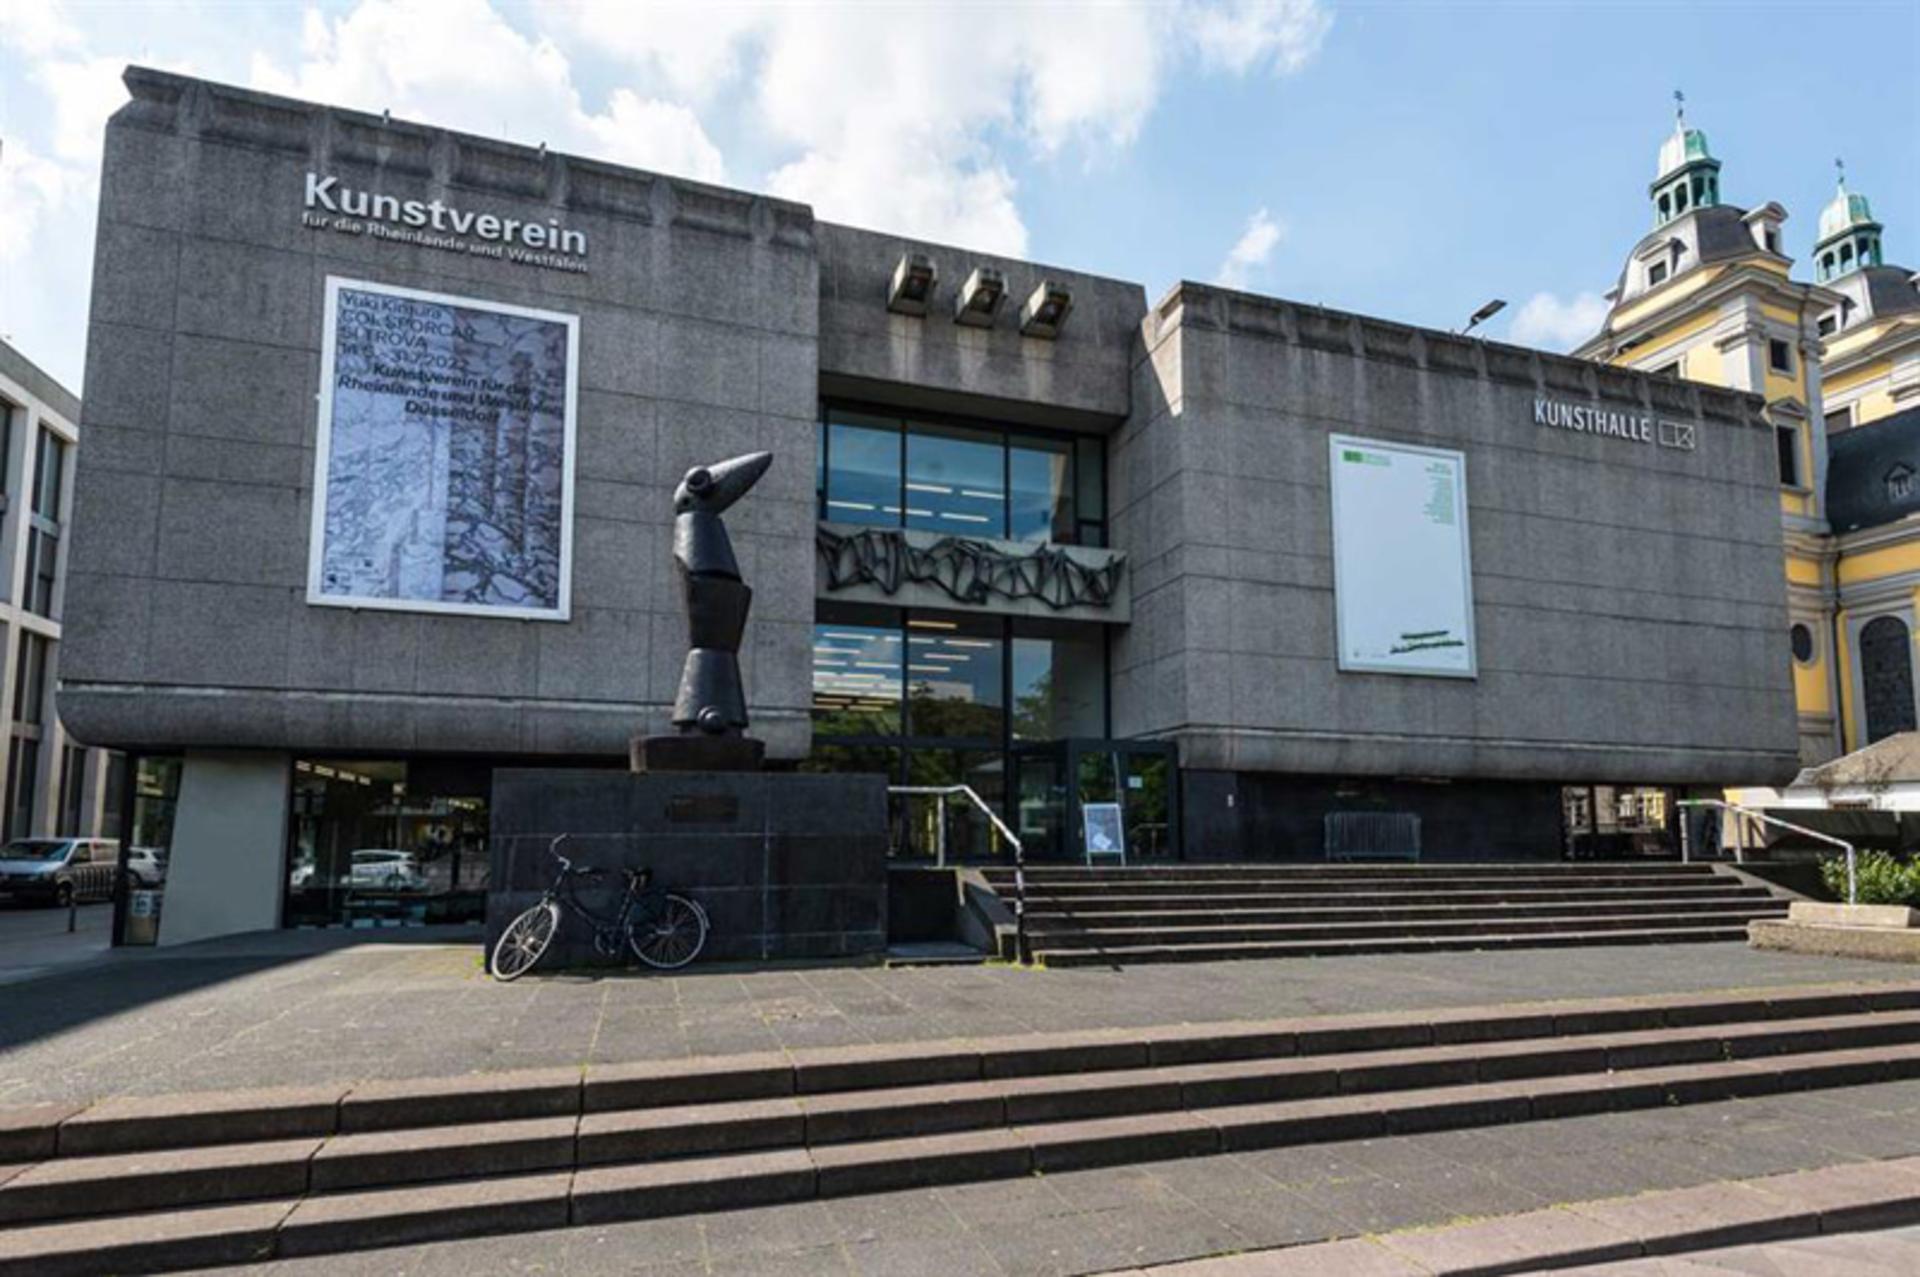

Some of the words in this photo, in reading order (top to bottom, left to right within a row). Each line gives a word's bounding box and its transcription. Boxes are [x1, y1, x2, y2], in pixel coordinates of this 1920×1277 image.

[306, 172, 587, 254] Kunstverein
[334, 218, 361, 233] die
[366, 222, 464, 250] Rheinlande
[470, 243, 502, 258] und
[508, 248, 588, 272] Westfalen
[338, 374, 438, 400] Rheinlande
[441, 390, 475, 405] und
[373, 362, 477, 389] Kunstverein
[405, 400, 499, 422] Düsseldorf
[1534, 397, 1651, 442] KUNSTHALLE
